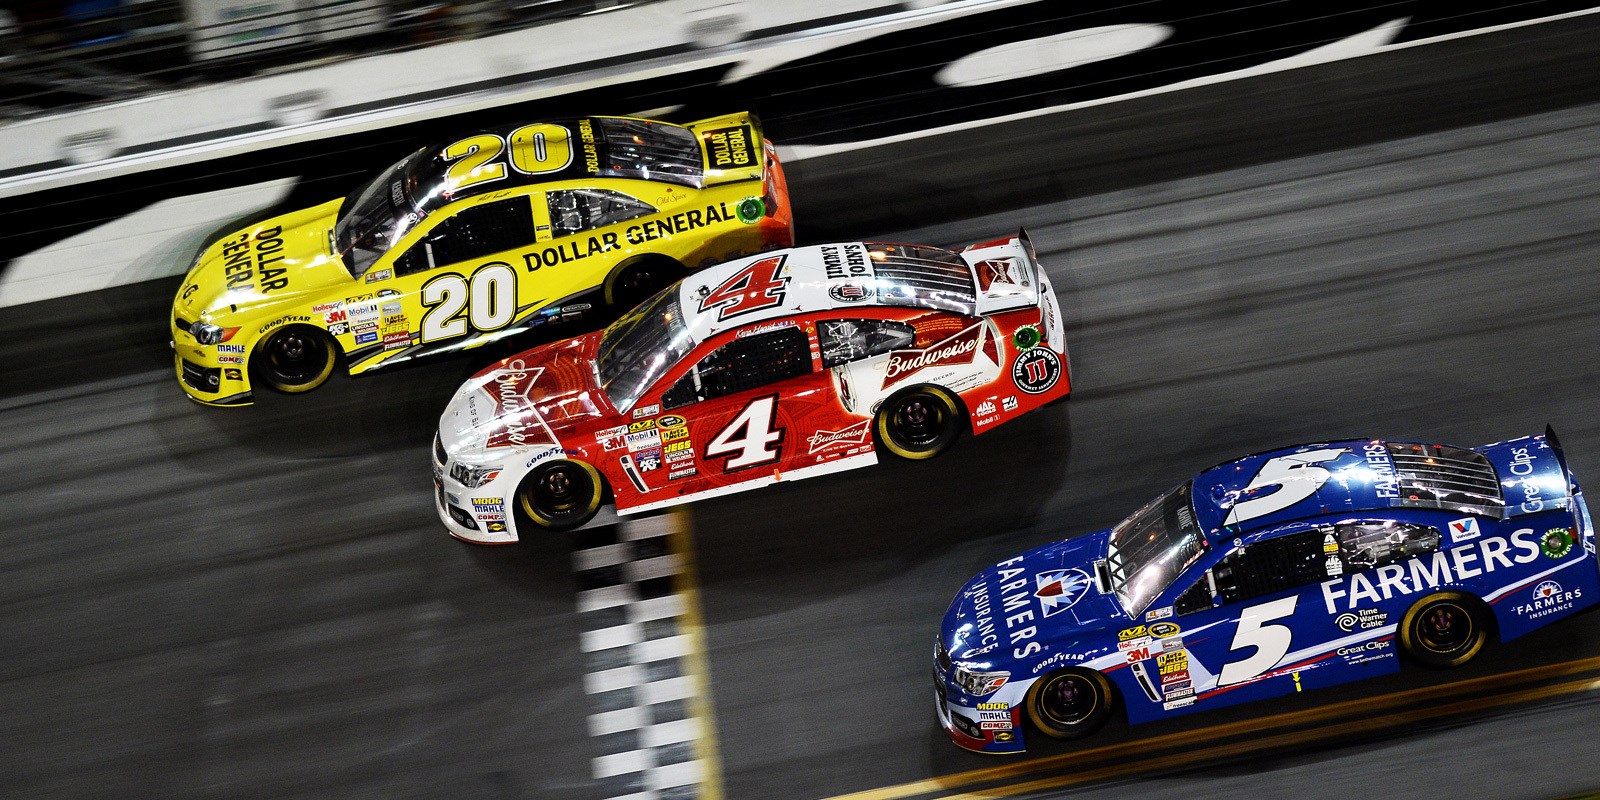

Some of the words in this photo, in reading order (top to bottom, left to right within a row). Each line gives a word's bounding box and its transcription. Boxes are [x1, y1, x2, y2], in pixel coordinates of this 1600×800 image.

[578, 118, 596, 144] GENERAL
[712, 132, 731, 166] DOLLAR
[728, 128, 749, 165] GENERAL
[442, 123, 574, 197] 20
[584, 143, 600, 173] DOLLAR
[522, 231, 621, 273] DOLLAR
[626, 202, 735, 245] GENERAL
[255, 225, 289, 294] DOLLAR
[820, 246, 849, 279] JIMMY
[843, 244, 872, 278] JOHN'S
[697, 254, 792, 322] 4
[348, 305, 370, 316] Mobil
[420, 261, 518, 345] 20
[259, 315, 311, 334] GOODYEAR
[326, 310, 347, 324] 3M
[218, 345, 245, 353] MAHLE
[885, 336, 987, 378] Budweiser
[1016, 352, 1031, 377] JIMMY
[1033, 350, 1057, 366] JOHN'S
[976, 416, 994, 427] Mobil
[605, 436, 627, 450] 3M
[627, 431, 649, 442] Mobil
[703, 392, 786, 474] 4
[806, 428, 870, 445] Budweiser
[526, 446, 579, 468] GOODYEAR
[664, 440, 691, 453] JEGS
[1362, 444, 1400, 498] FAMERS
[1509, 447, 1537, 476] Clips
[1223, 448, 1351, 526] 5
[475, 504, 504, 513] MAHLE
[1541, 527, 1569, 546] AMERICAN
[1545, 544, 1573, 559] ETHANOL
[1319, 528, 1541, 615] FARMERS
[996, 555, 1041, 659] FARMERS
[1358, 608, 1378, 617] Time
[1516, 588, 1582, 616] FARMERS
[1529, 602, 1573, 620] INSURANCE
[971, 581, 999, 652] INSURANCE
[1359, 613, 1387, 622] Warner
[1360, 620, 1383, 629] Cable
[1216, 594, 1300, 687] 5
[1337, 645, 1366, 656] Great
[1366, 641, 1390, 650] Clips
[1032, 652, 1085, 674] GOODYEAR
[1126, 647, 1150, 662] 3M
[1165, 657, 1186, 665] Meter
[1166, 652, 1182, 660] Auto
[1160, 661, 1188, 675] JEGS
[976, 702, 1009, 711] MOOG
[980, 711, 1011, 719] MAHLE
